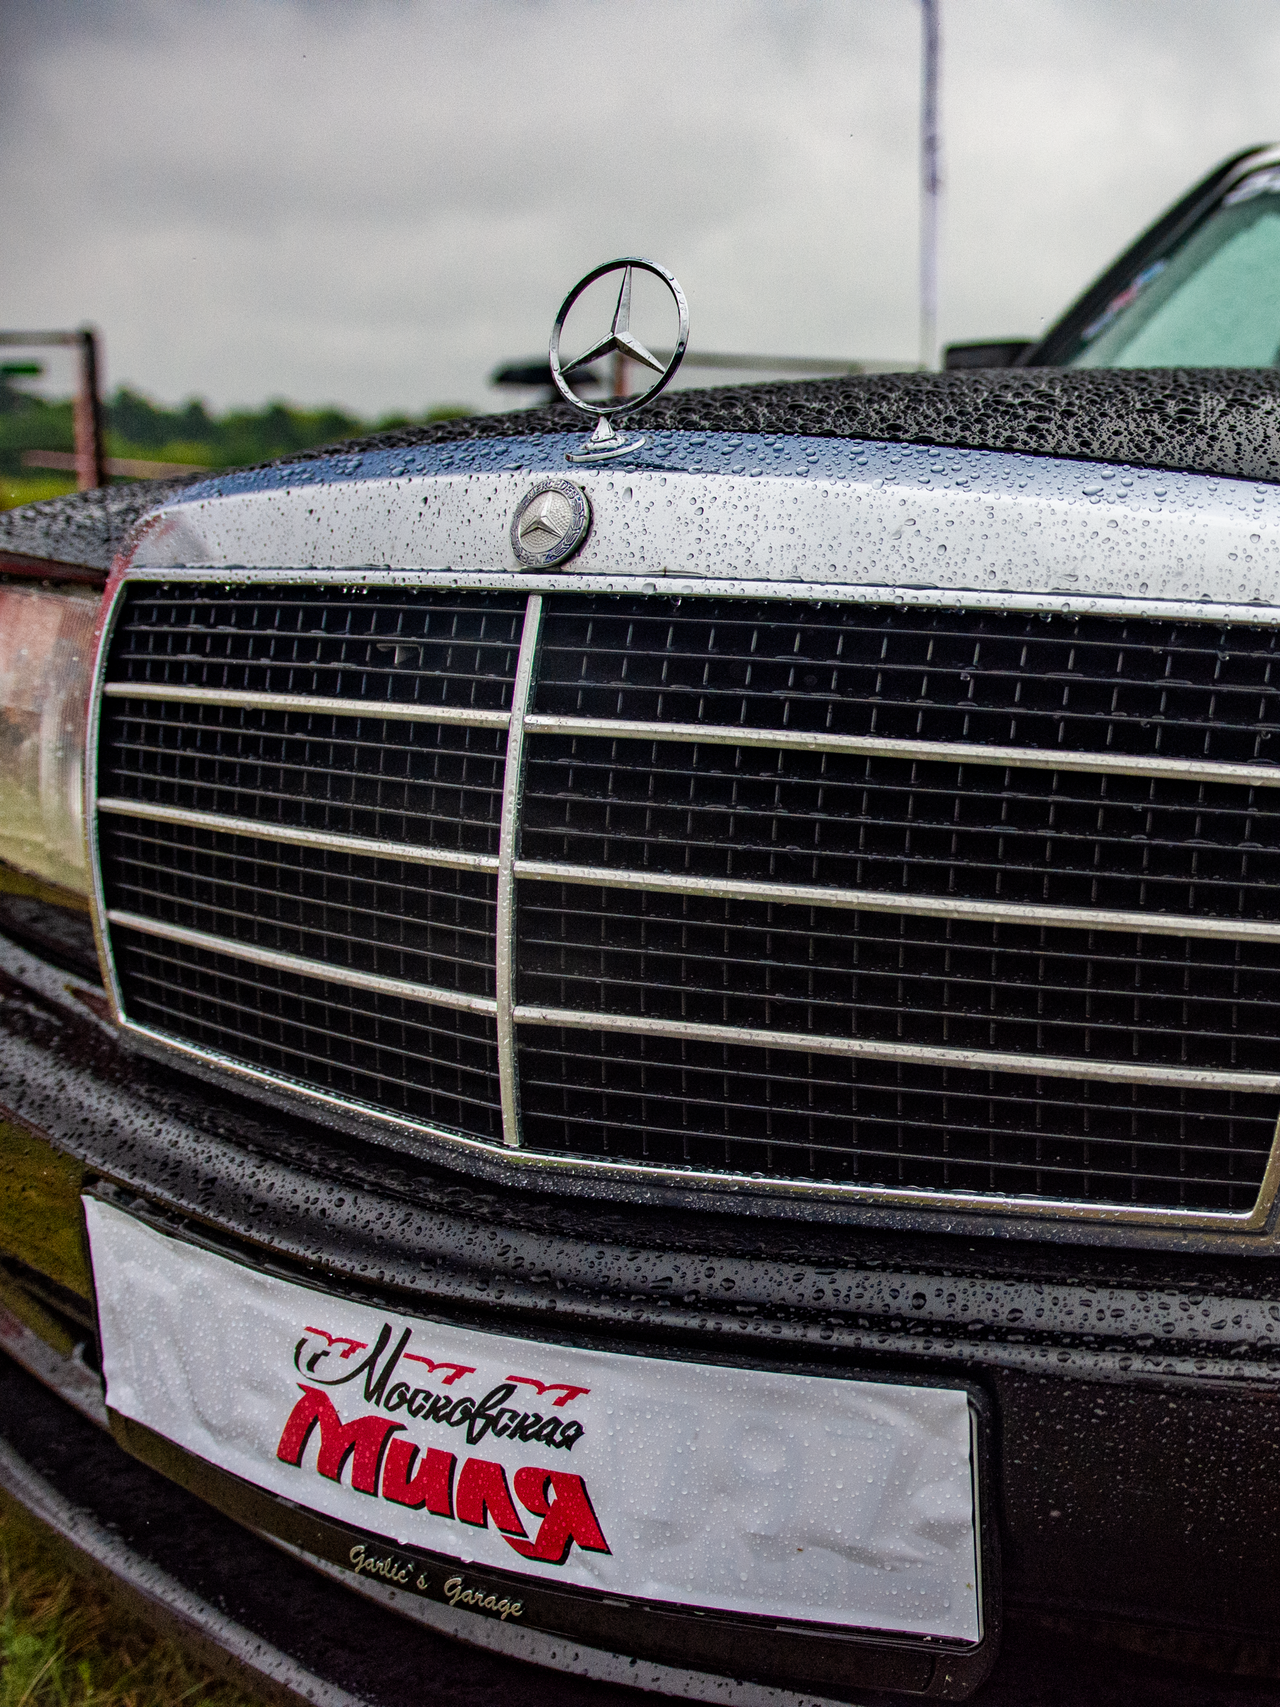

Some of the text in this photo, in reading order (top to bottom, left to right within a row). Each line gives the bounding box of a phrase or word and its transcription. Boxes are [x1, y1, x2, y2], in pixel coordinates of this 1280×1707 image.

[527, 480, 580, 501] MERCEDES
[520, 551, 550, 567] BENZ
[294, 1322, 585, 1451] Московская
[276, 1382, 613, 1566] Миля
[443, 1577, 524, 1620] Garage
